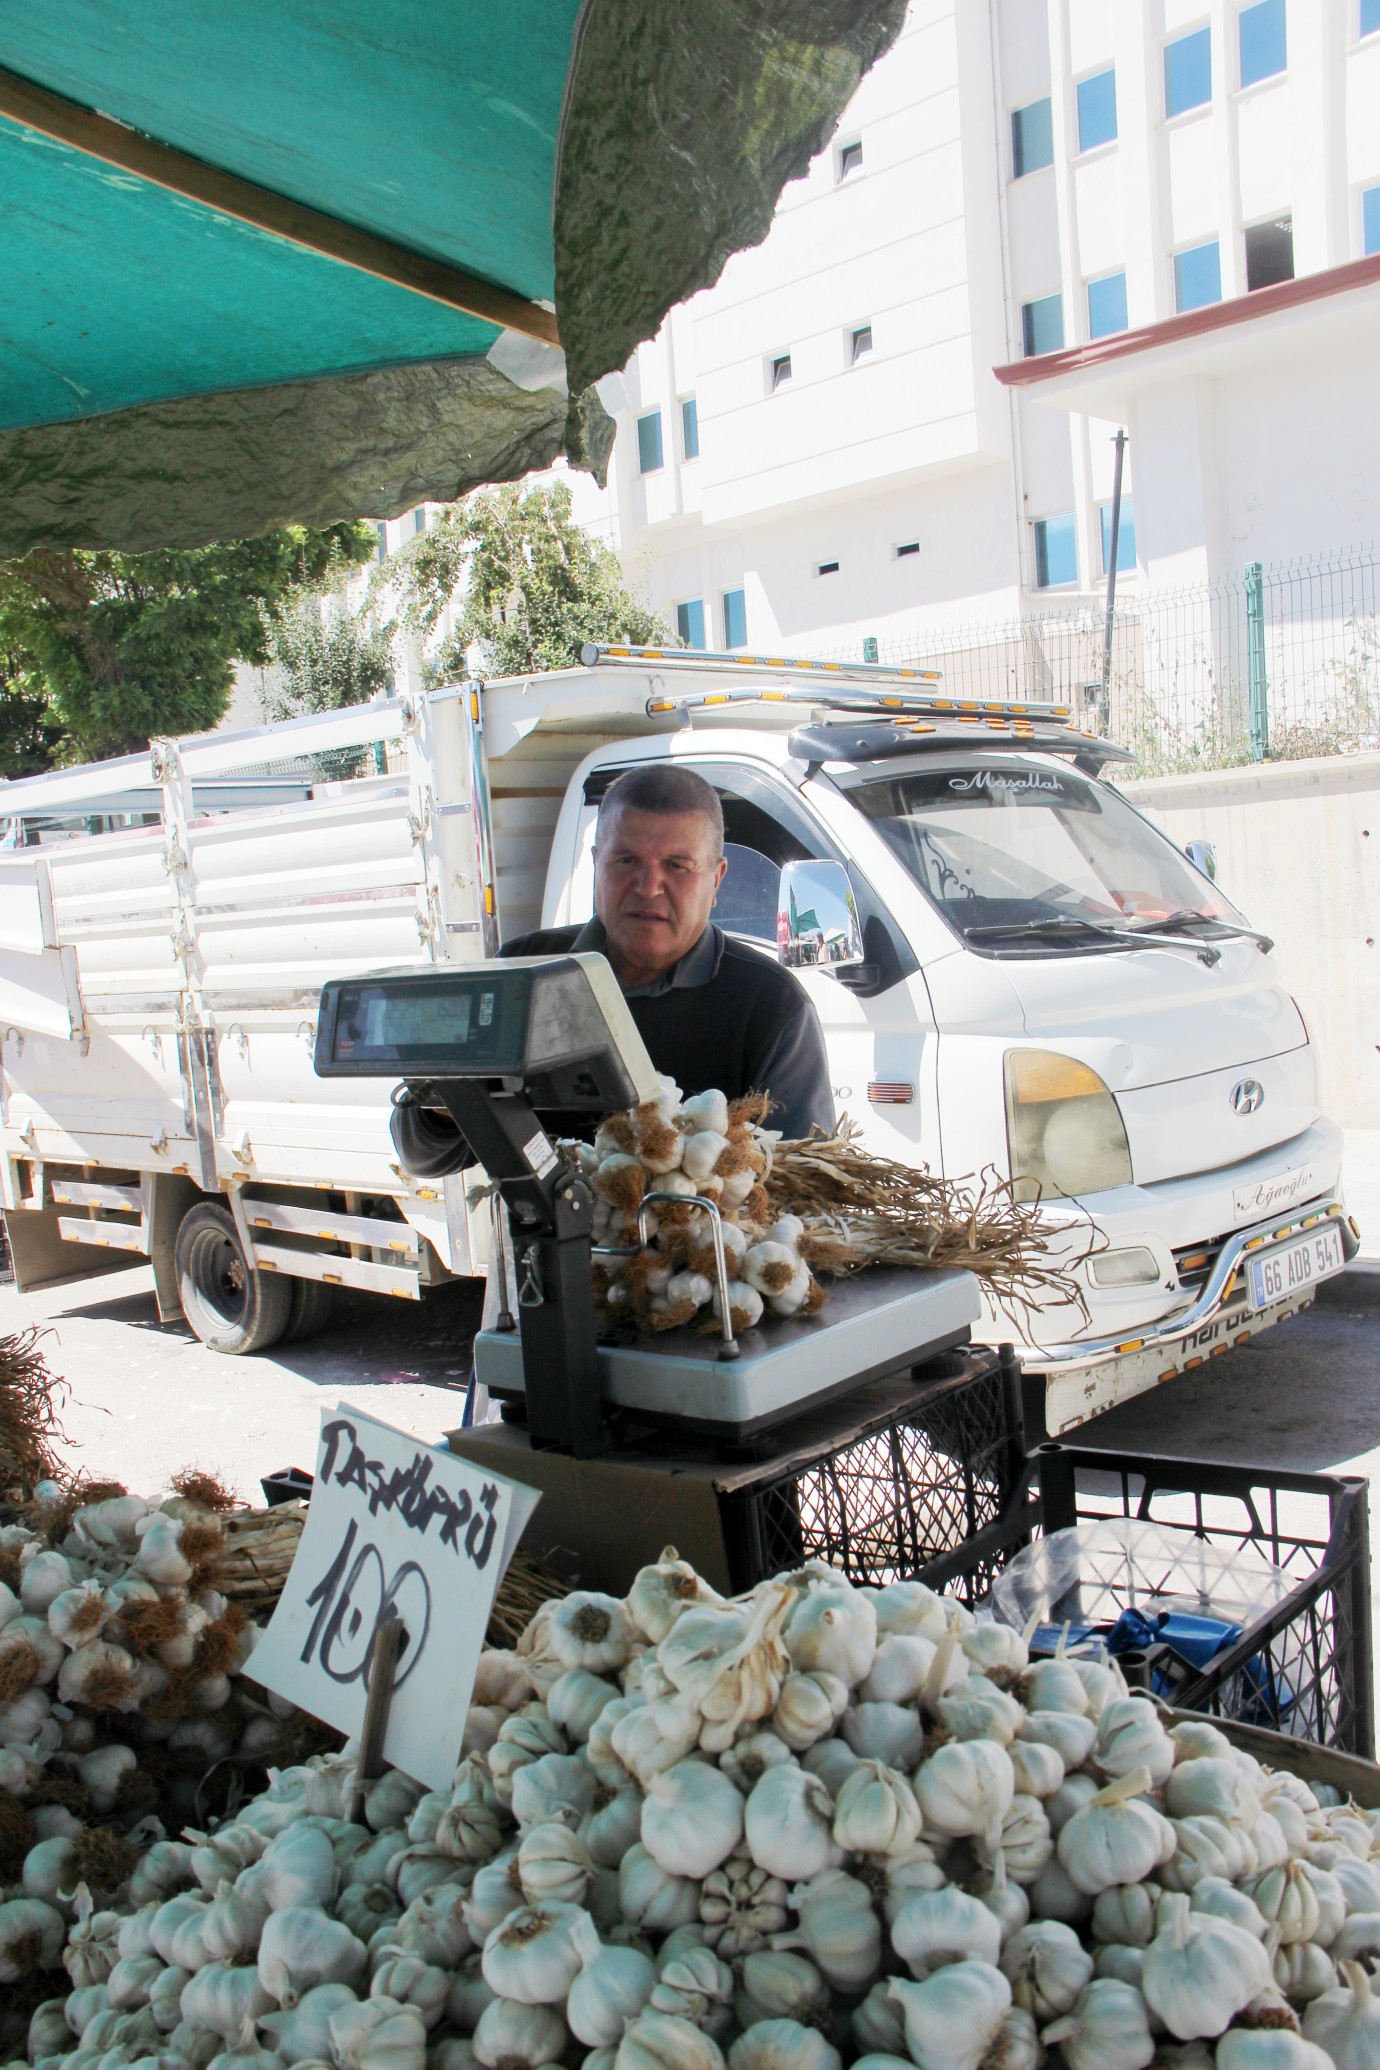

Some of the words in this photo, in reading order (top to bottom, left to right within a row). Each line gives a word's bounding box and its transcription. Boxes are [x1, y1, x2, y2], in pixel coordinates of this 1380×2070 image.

[1264, 1259, 1282, 1296] 66
[1288, 1246, 1312, 1287] ADB
[1315, 1233, 1340, 1272] 541
[300, 1517, 432, 1695] 100
